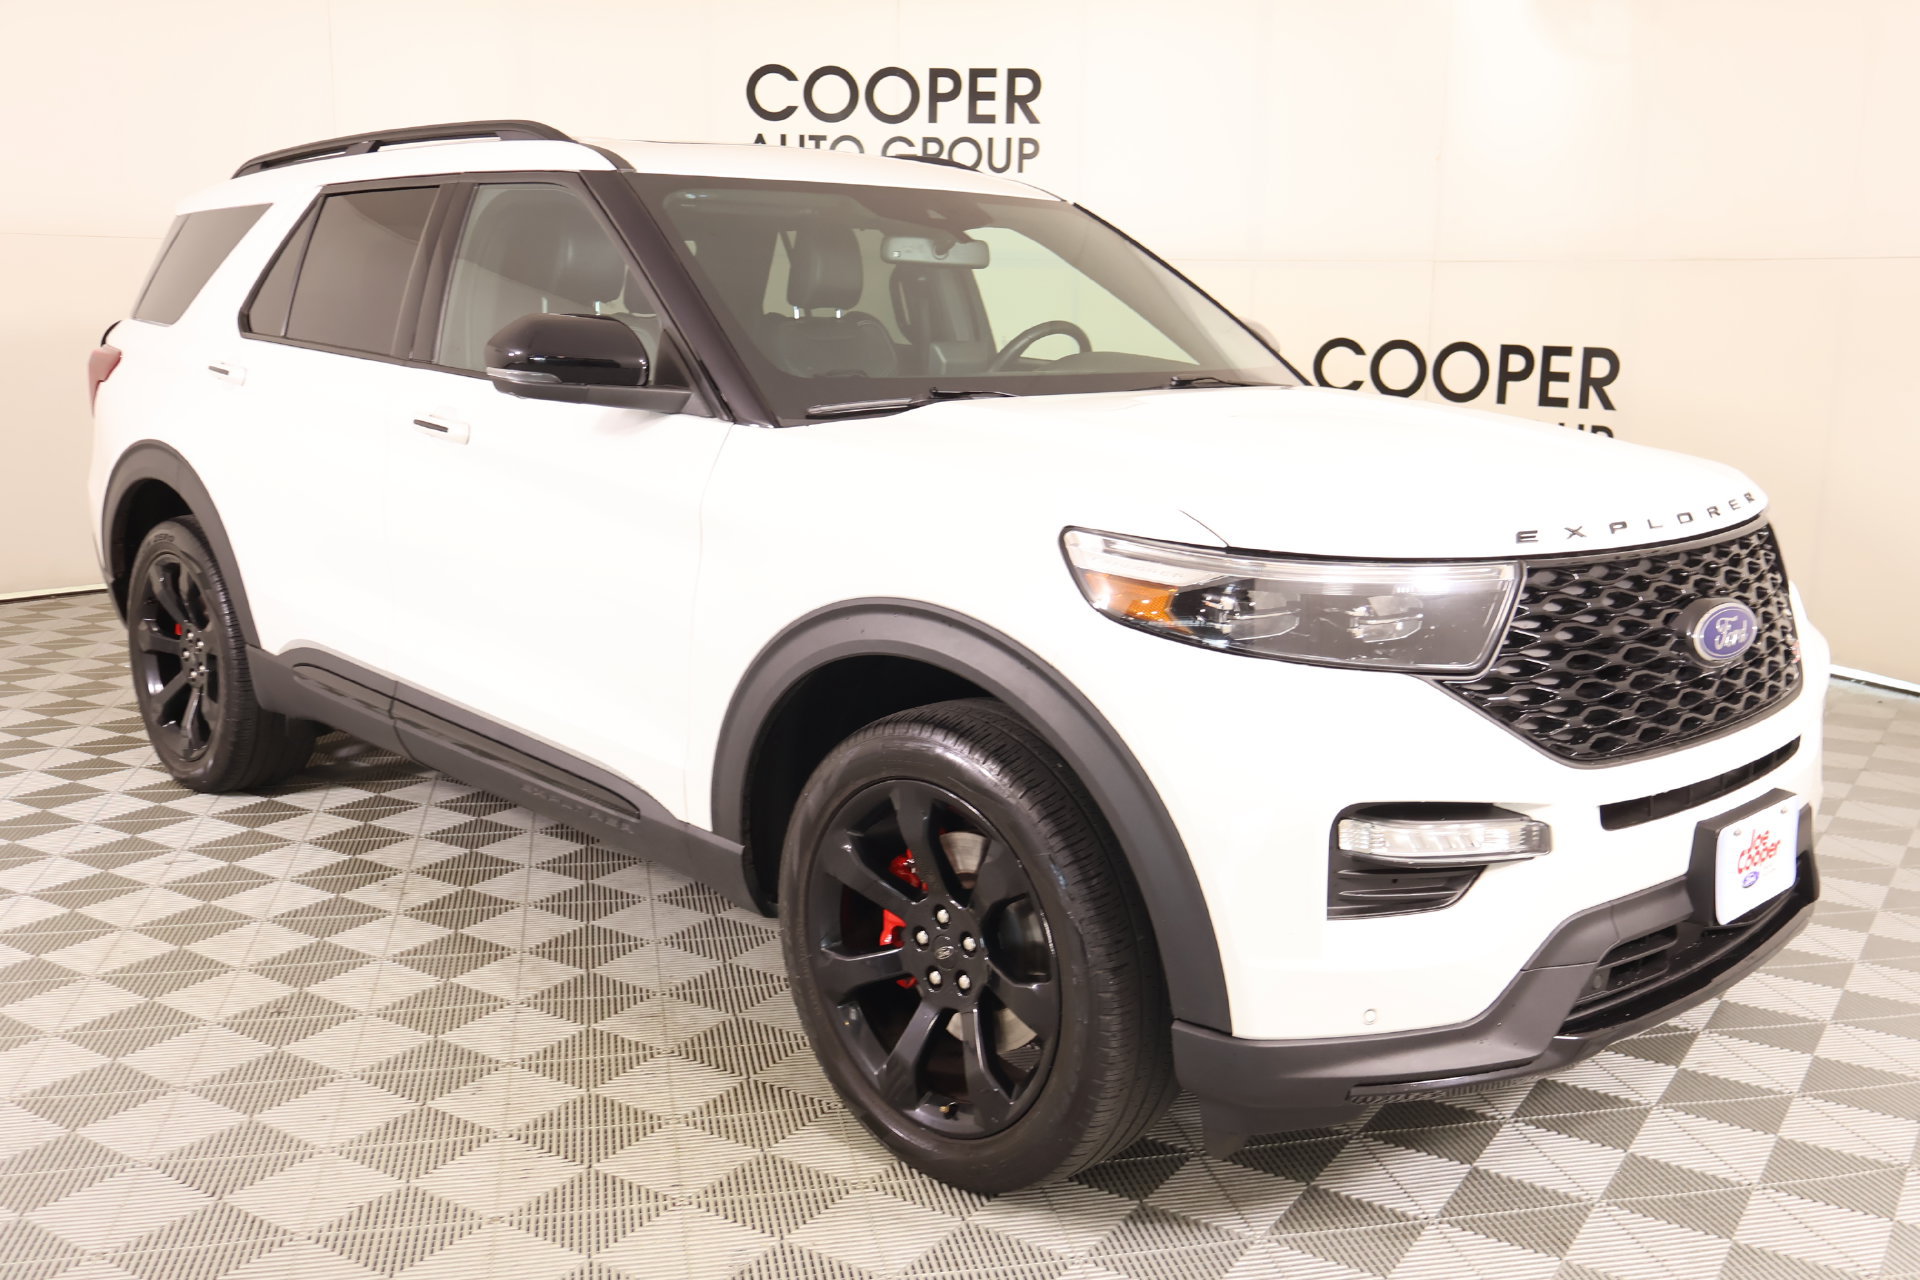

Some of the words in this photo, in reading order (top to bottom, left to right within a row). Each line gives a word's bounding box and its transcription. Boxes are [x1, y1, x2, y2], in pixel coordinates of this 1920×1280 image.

[747, 64, 1041, 124] COOPER
[1313, 337, 1620, 411] COOPER
[1516, 492, 1755, 544] EXPLORER
[1715, 615, 1748, 650] Ford
